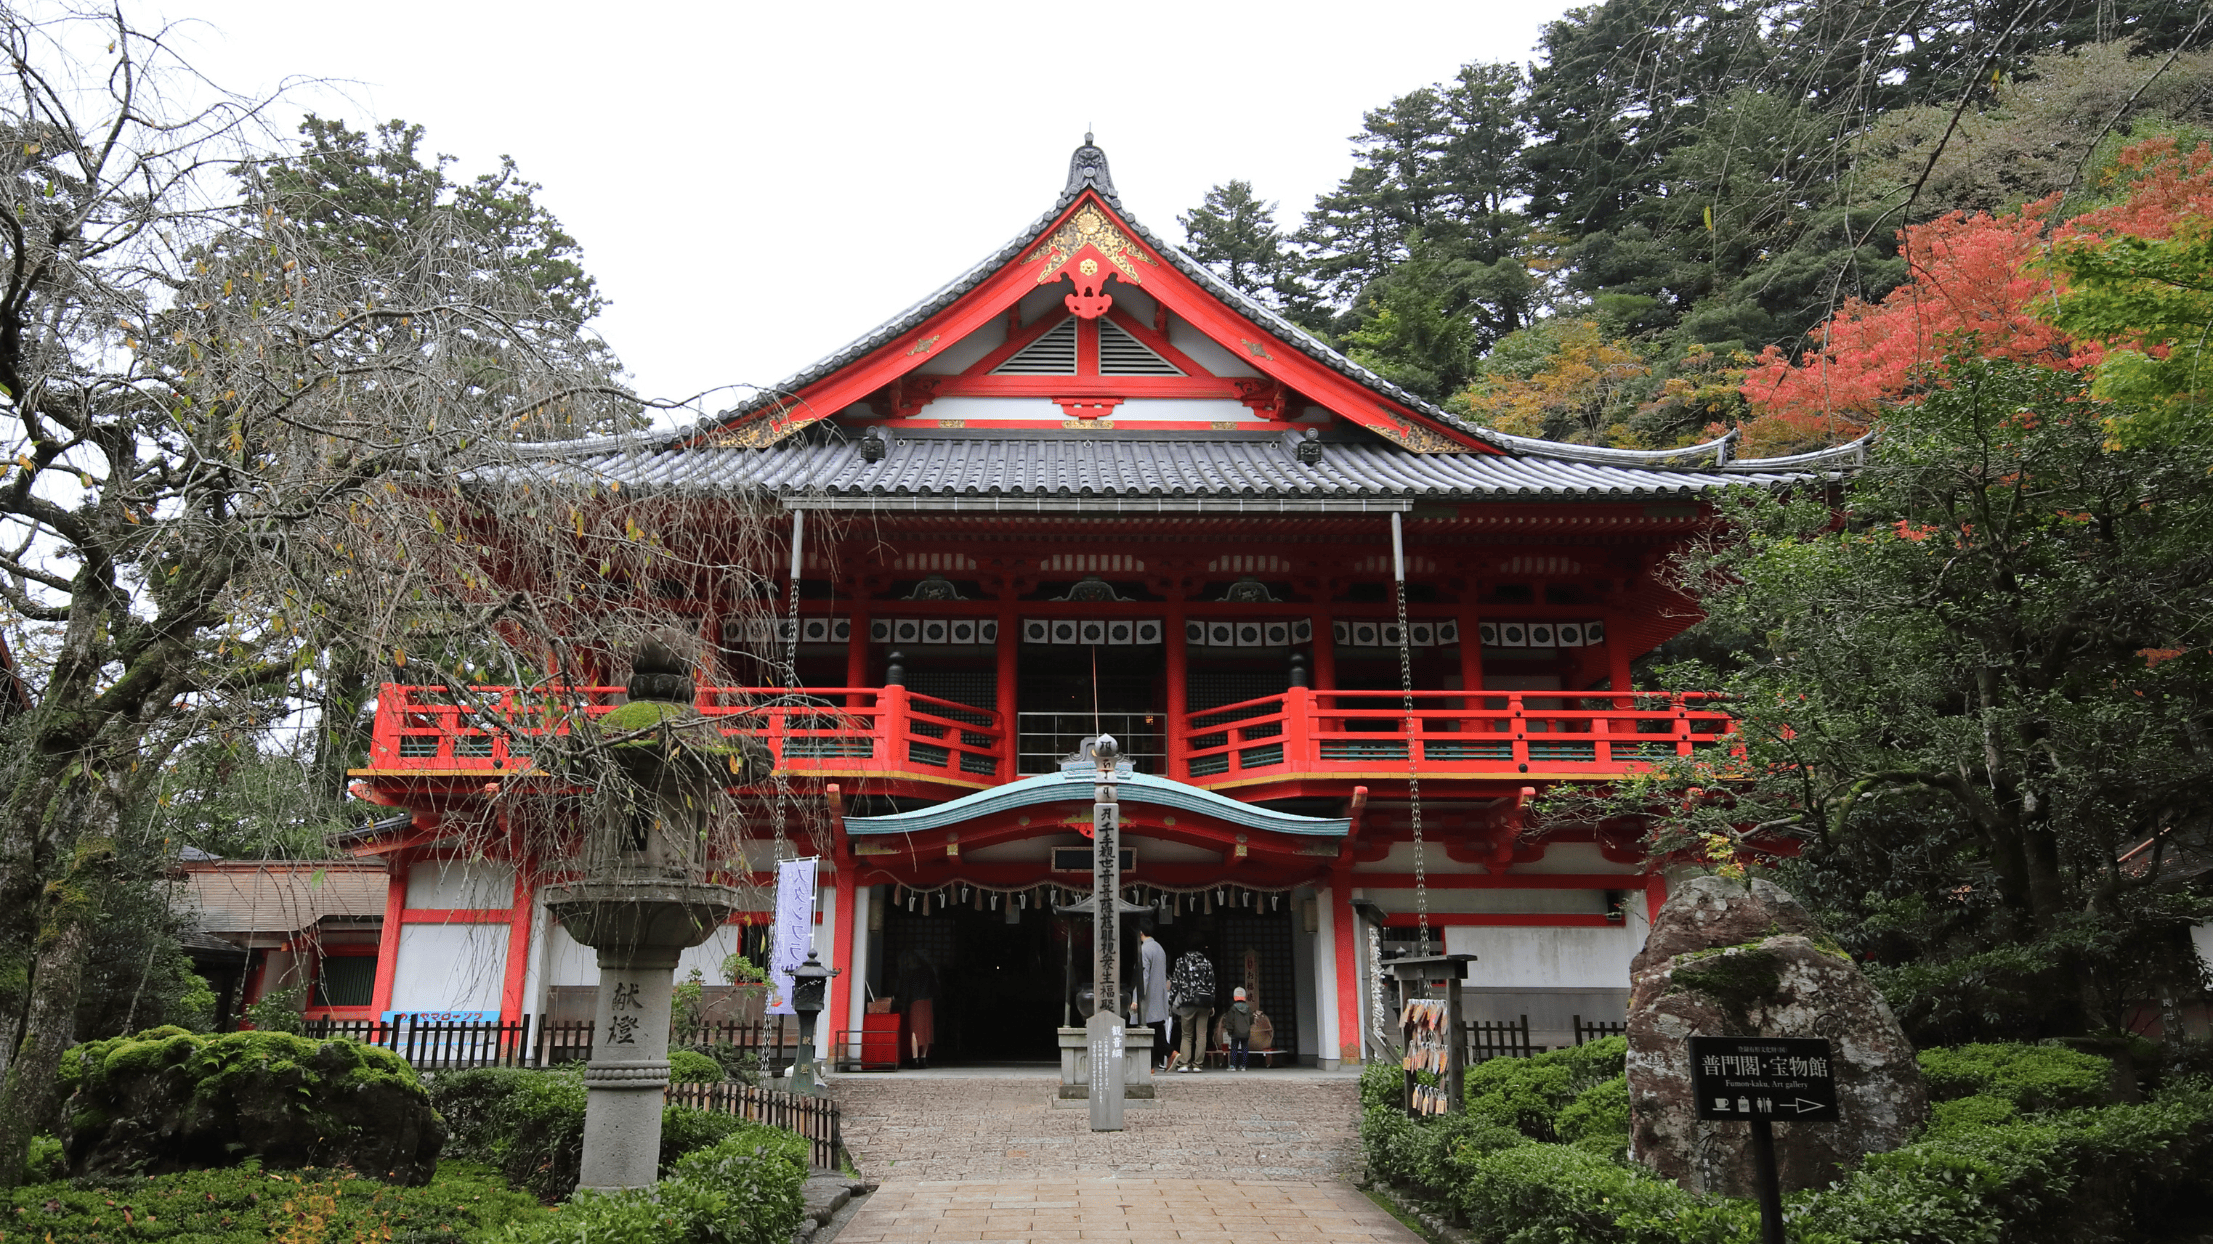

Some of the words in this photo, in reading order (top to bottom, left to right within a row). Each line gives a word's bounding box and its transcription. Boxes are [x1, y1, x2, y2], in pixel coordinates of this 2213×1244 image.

[1702, 1055, 1828, 1078] 普門閣・宝物館
[1725, 1080, 1770, 1088] Fumon-kaku,
[1772, 1080, 1784, 1088] Art
[1785, 1080, 1808, 1090] gallery
